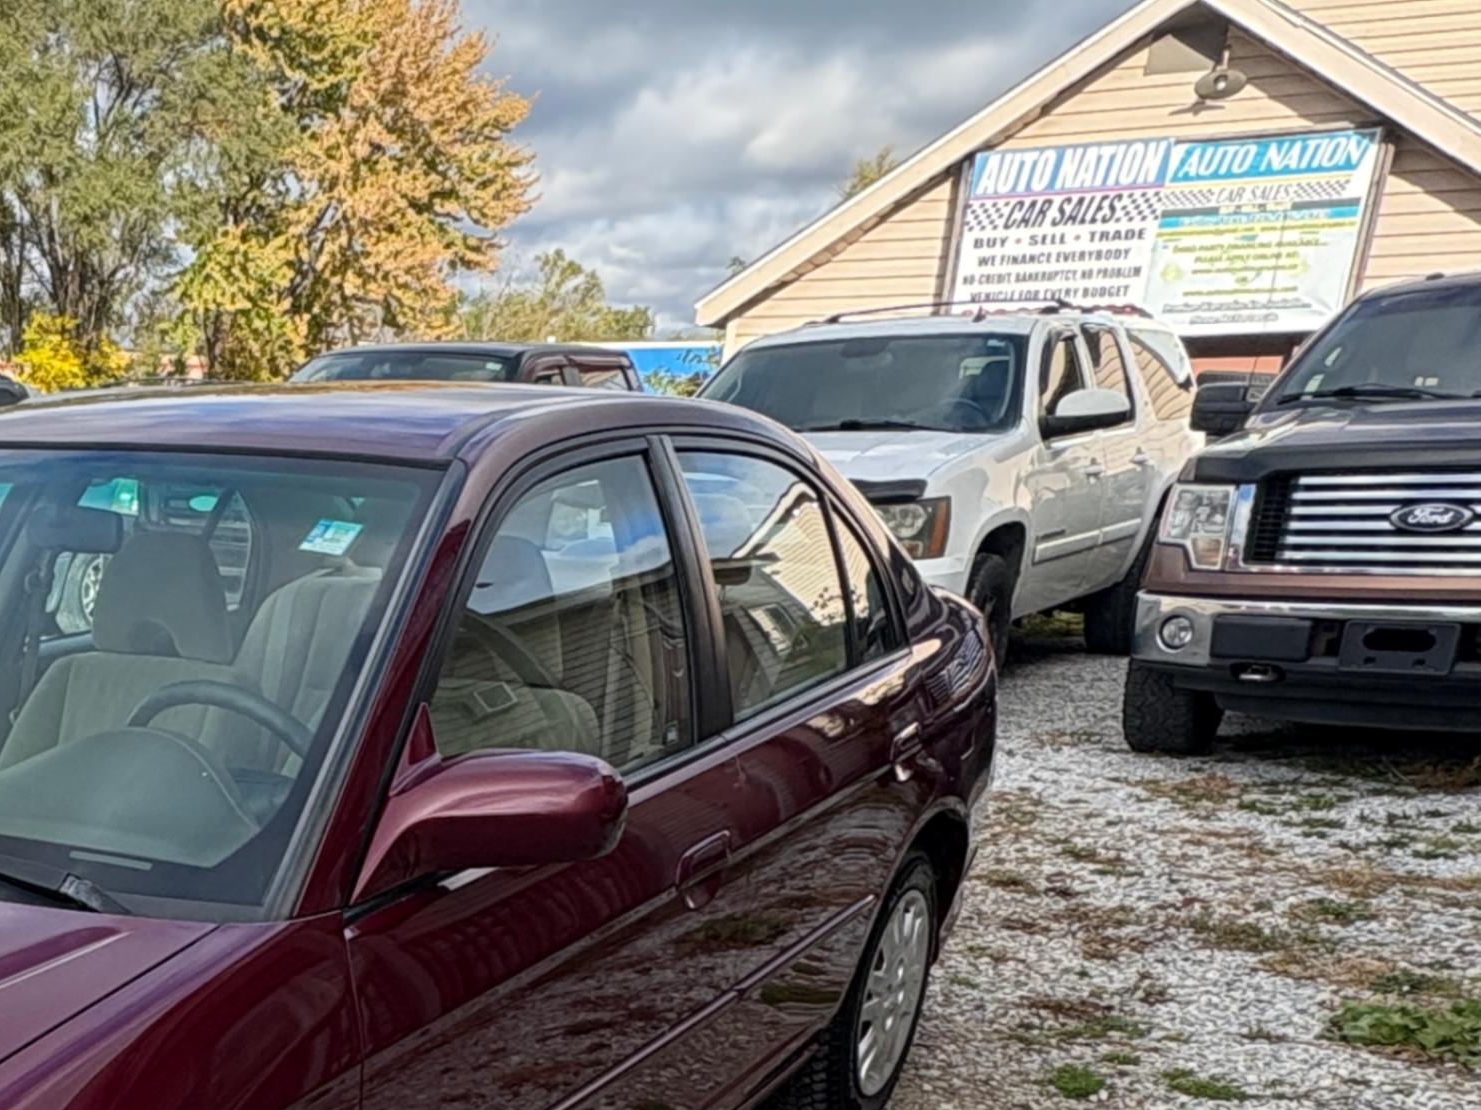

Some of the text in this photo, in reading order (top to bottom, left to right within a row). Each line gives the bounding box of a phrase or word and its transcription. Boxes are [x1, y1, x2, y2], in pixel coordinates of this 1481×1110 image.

[1178, 134, 1371, 178] AUTO NATION
[975, 139, 1169, 195] AUTO NATION
[1216, 184, 1292, 204] CAR SALES
[1003, 193, 1124, 229] CAR SALES
[973, 236, 1009, 249] BUY
[1028, 232, 1067, 246] SELL
[1088, 228, 1147, 243] TRADE
[978, 247, 1131, 267] WE FINANCE EVERYBODY
[962, 274, 975, 285] NO
[1081, 268, 1093, 279] NO
[1096, 266, 1142, 279] PROBLEM
[1018, 289, 1040, 301] FOR
[1043, 287, 1079, 301] EVERY
[1082, 285, 1130, 299] BUDGET
[1407, 507, 1454, 524] Ford
